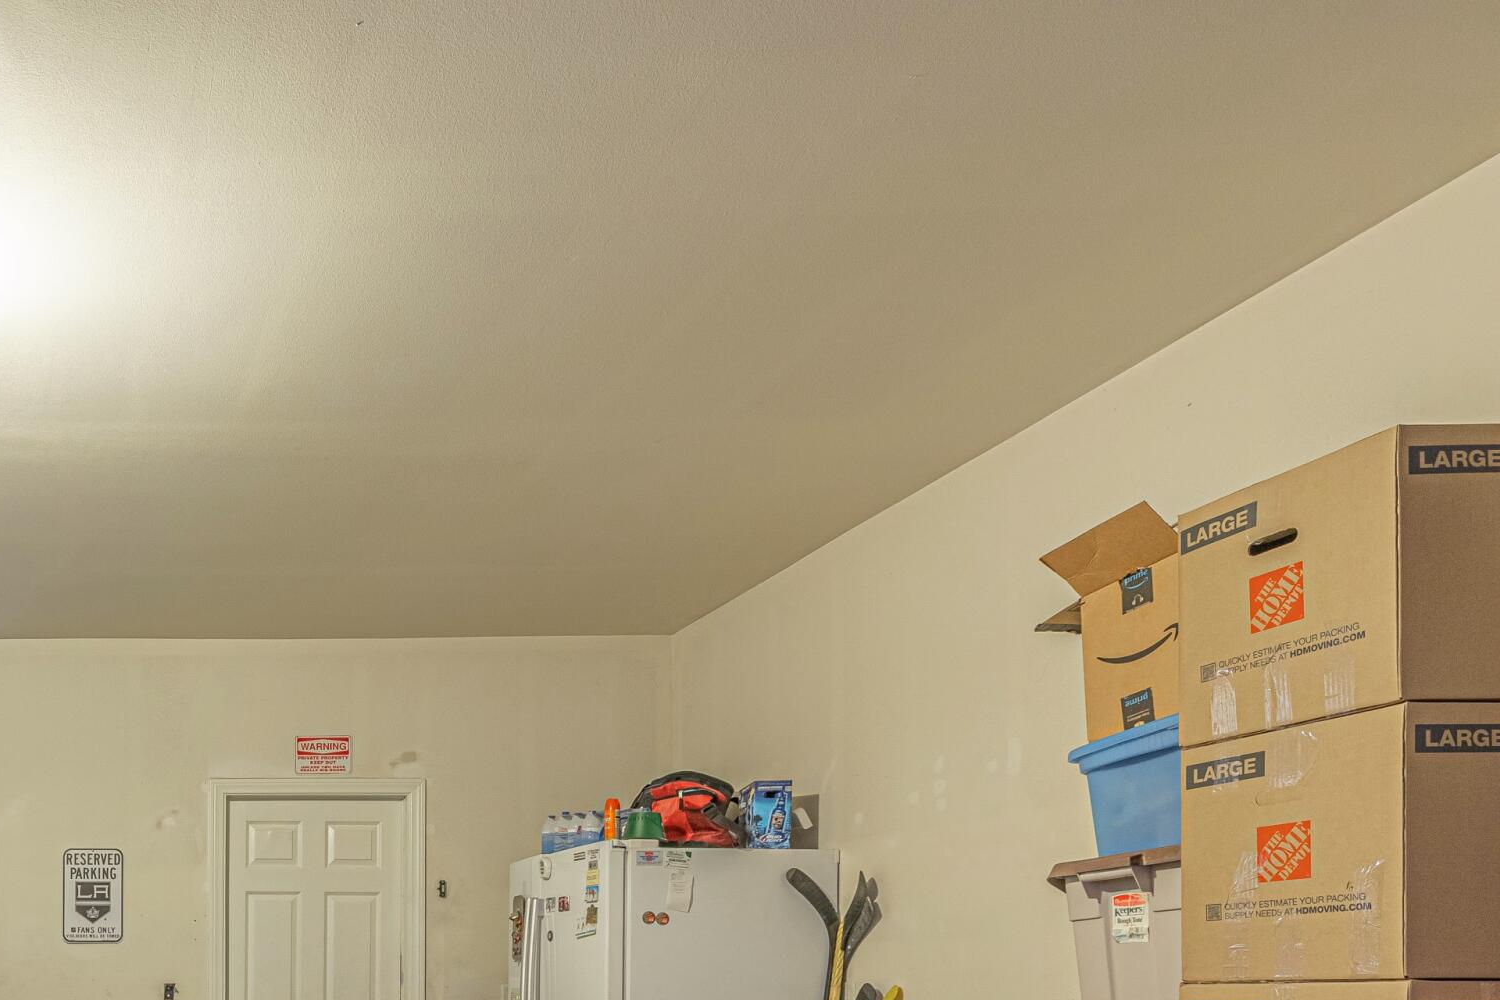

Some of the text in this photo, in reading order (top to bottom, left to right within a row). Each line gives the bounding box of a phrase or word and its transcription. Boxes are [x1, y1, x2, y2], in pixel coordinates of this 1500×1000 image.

[1420, 450, 1500, 469] LARGE
[1187, 509, 1248, 548] LARGE
[1124, 569, 1148, 585] prime
[1251, 565, 1303, 631] HOME
[1255, 578, 1276, 604] THE
[1270, 583, 1304, 626] DEPOT
[1219, 622, 1360, 668] QUICKLY ESTIMATE YOUR PACKING
[1250, 656, 1276, 668] NEEDS
[1278, 652, 1289, 660] AT
[1290, 631, 1365, 658] HDMOVING.COM
[1125, 691, 1148, 707] prime
[1194, 758, 1256, 784] LARGE
[1258, 822, 1311, 882] HOME
[1263, 831, 1284, 854] THE
[66, 853, 120, 865] RESERVED
[1277, 843, 1311, 880] DEPOT
[70, 868, 116, 879] PARKING
[77, 885, 109, 898] LA
[1224, 893, 1366, 911] QUICKLY ESTIMATE YOUR PACKING
[1115, 907, 1143, 916] Keepers
[1224, 903, 1372, 920] SUPPLY NEEDS AT HDMOVING.COM
